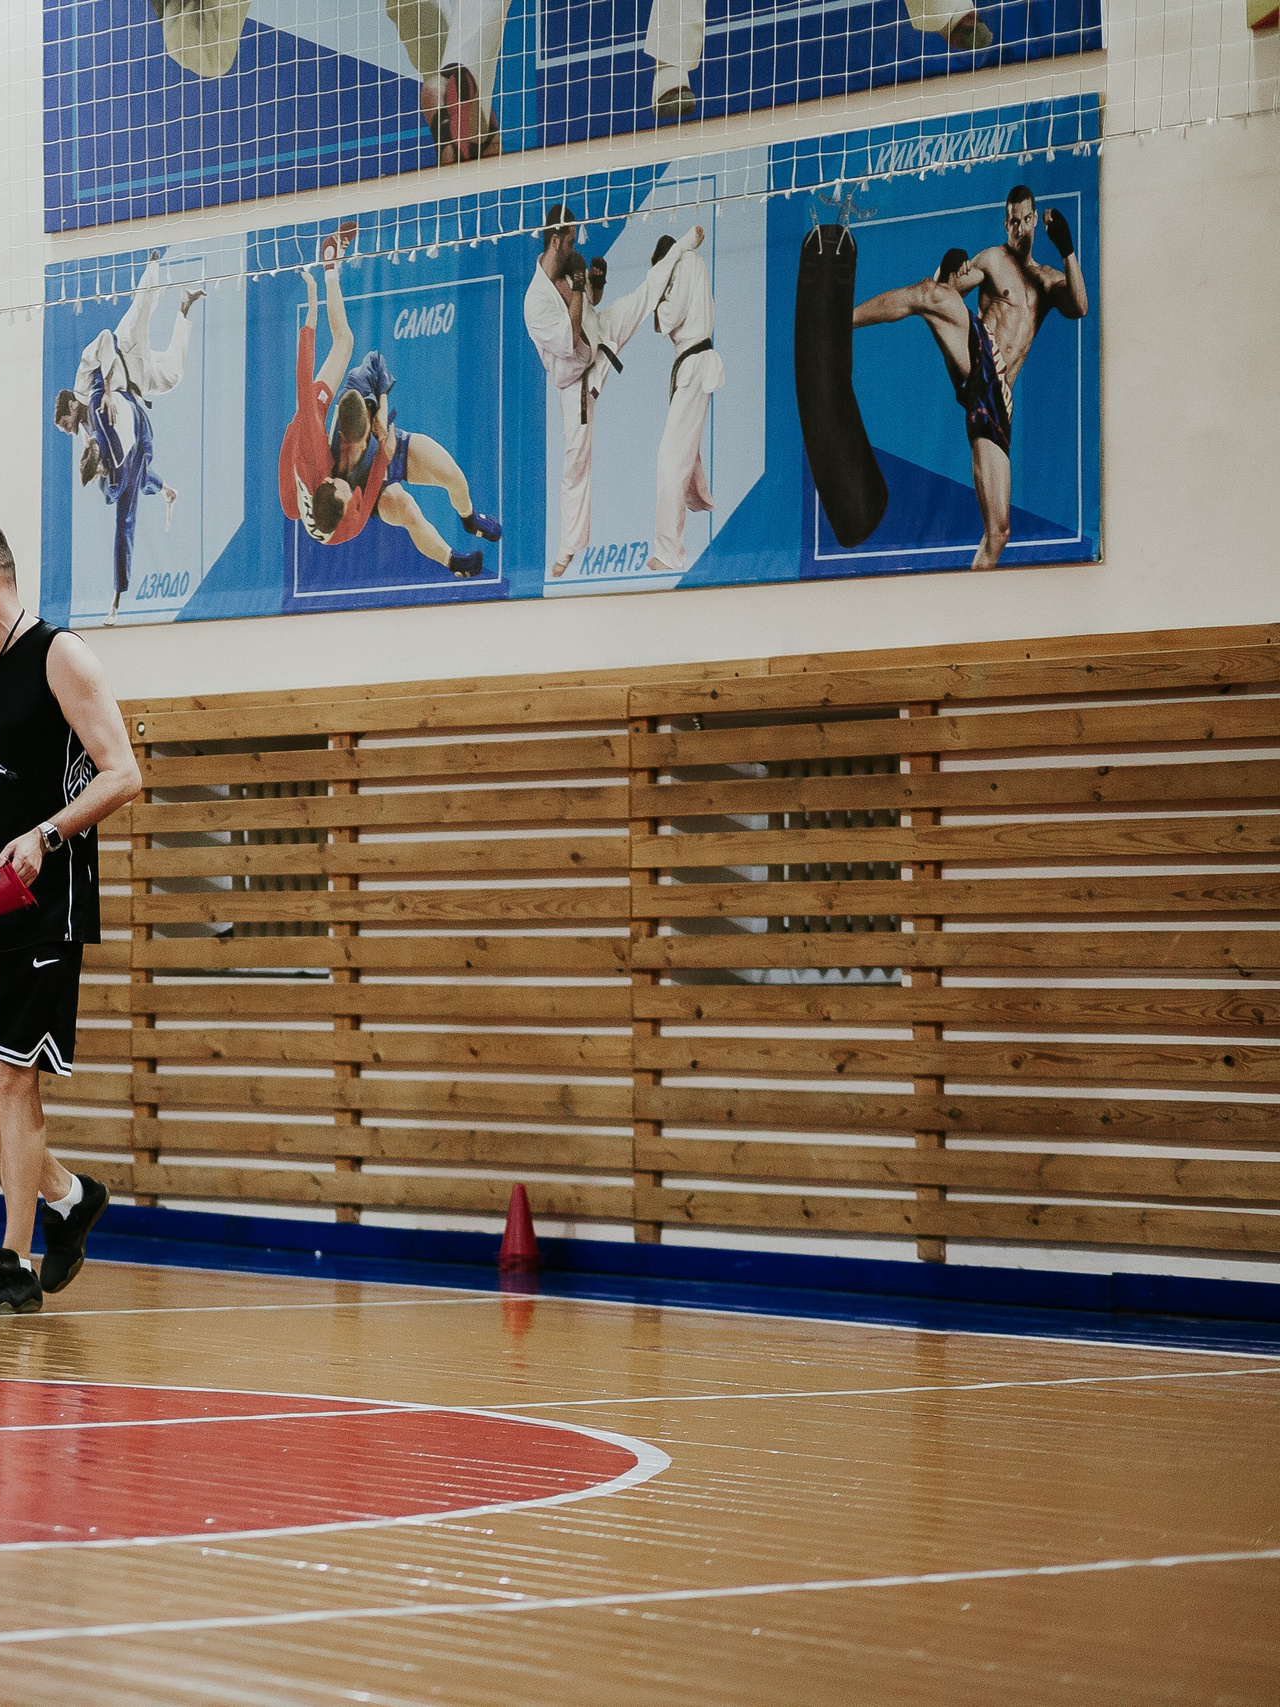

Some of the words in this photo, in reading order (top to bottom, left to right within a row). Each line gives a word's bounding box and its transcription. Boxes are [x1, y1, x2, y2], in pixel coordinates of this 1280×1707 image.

[393, 302, 455, 340] САМБО
[579, 541, 649, 575] КАРАТЭ
[135, 570, 190, 600] ДЗЮДО
